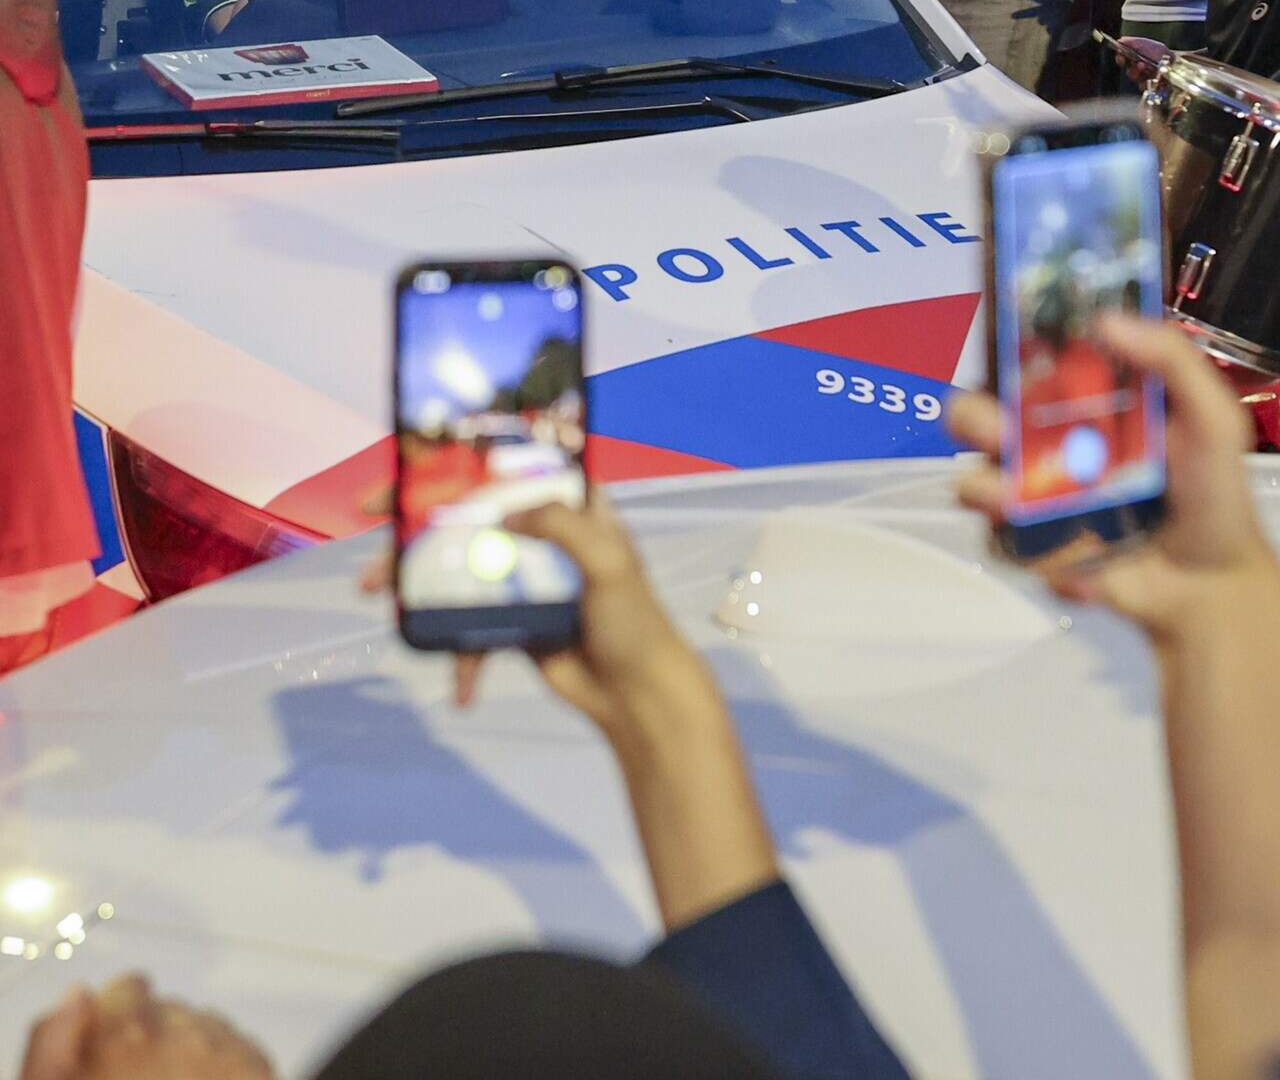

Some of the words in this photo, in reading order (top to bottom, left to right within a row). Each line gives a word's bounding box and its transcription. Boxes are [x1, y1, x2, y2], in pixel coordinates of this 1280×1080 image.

[217, 58, 371, 82] merci
[582, 211, 985, 303] POLITIE
[815, 368, 943, 422] 9339
